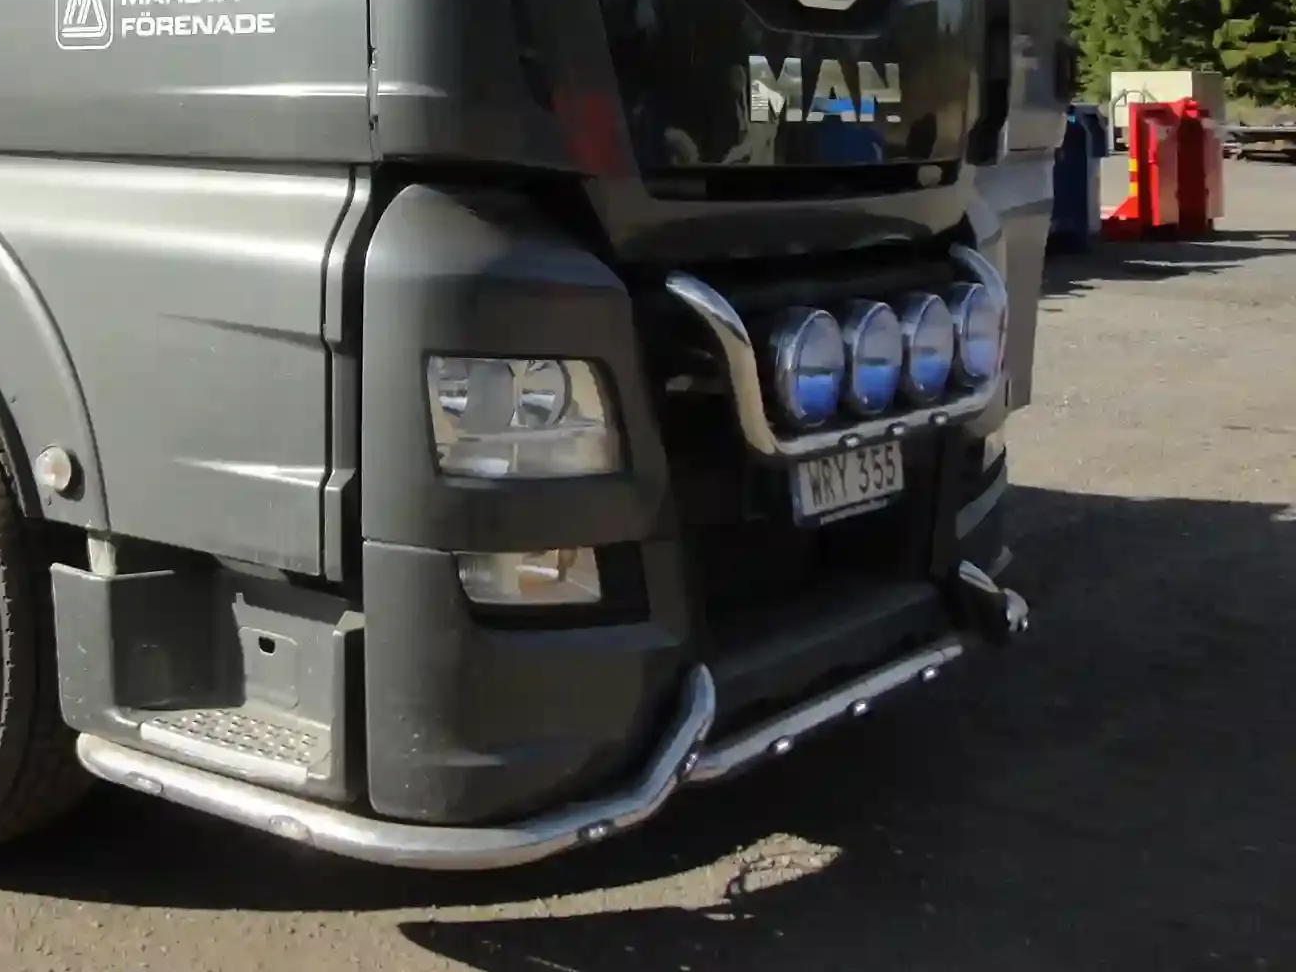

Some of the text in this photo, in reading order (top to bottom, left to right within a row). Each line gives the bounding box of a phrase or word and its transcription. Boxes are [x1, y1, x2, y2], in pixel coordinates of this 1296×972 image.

[122, 12, 275, 37] FÖRENADE
[749, 55, 901, 122] MAN
[808, 445, 895, 508] WRY 355
